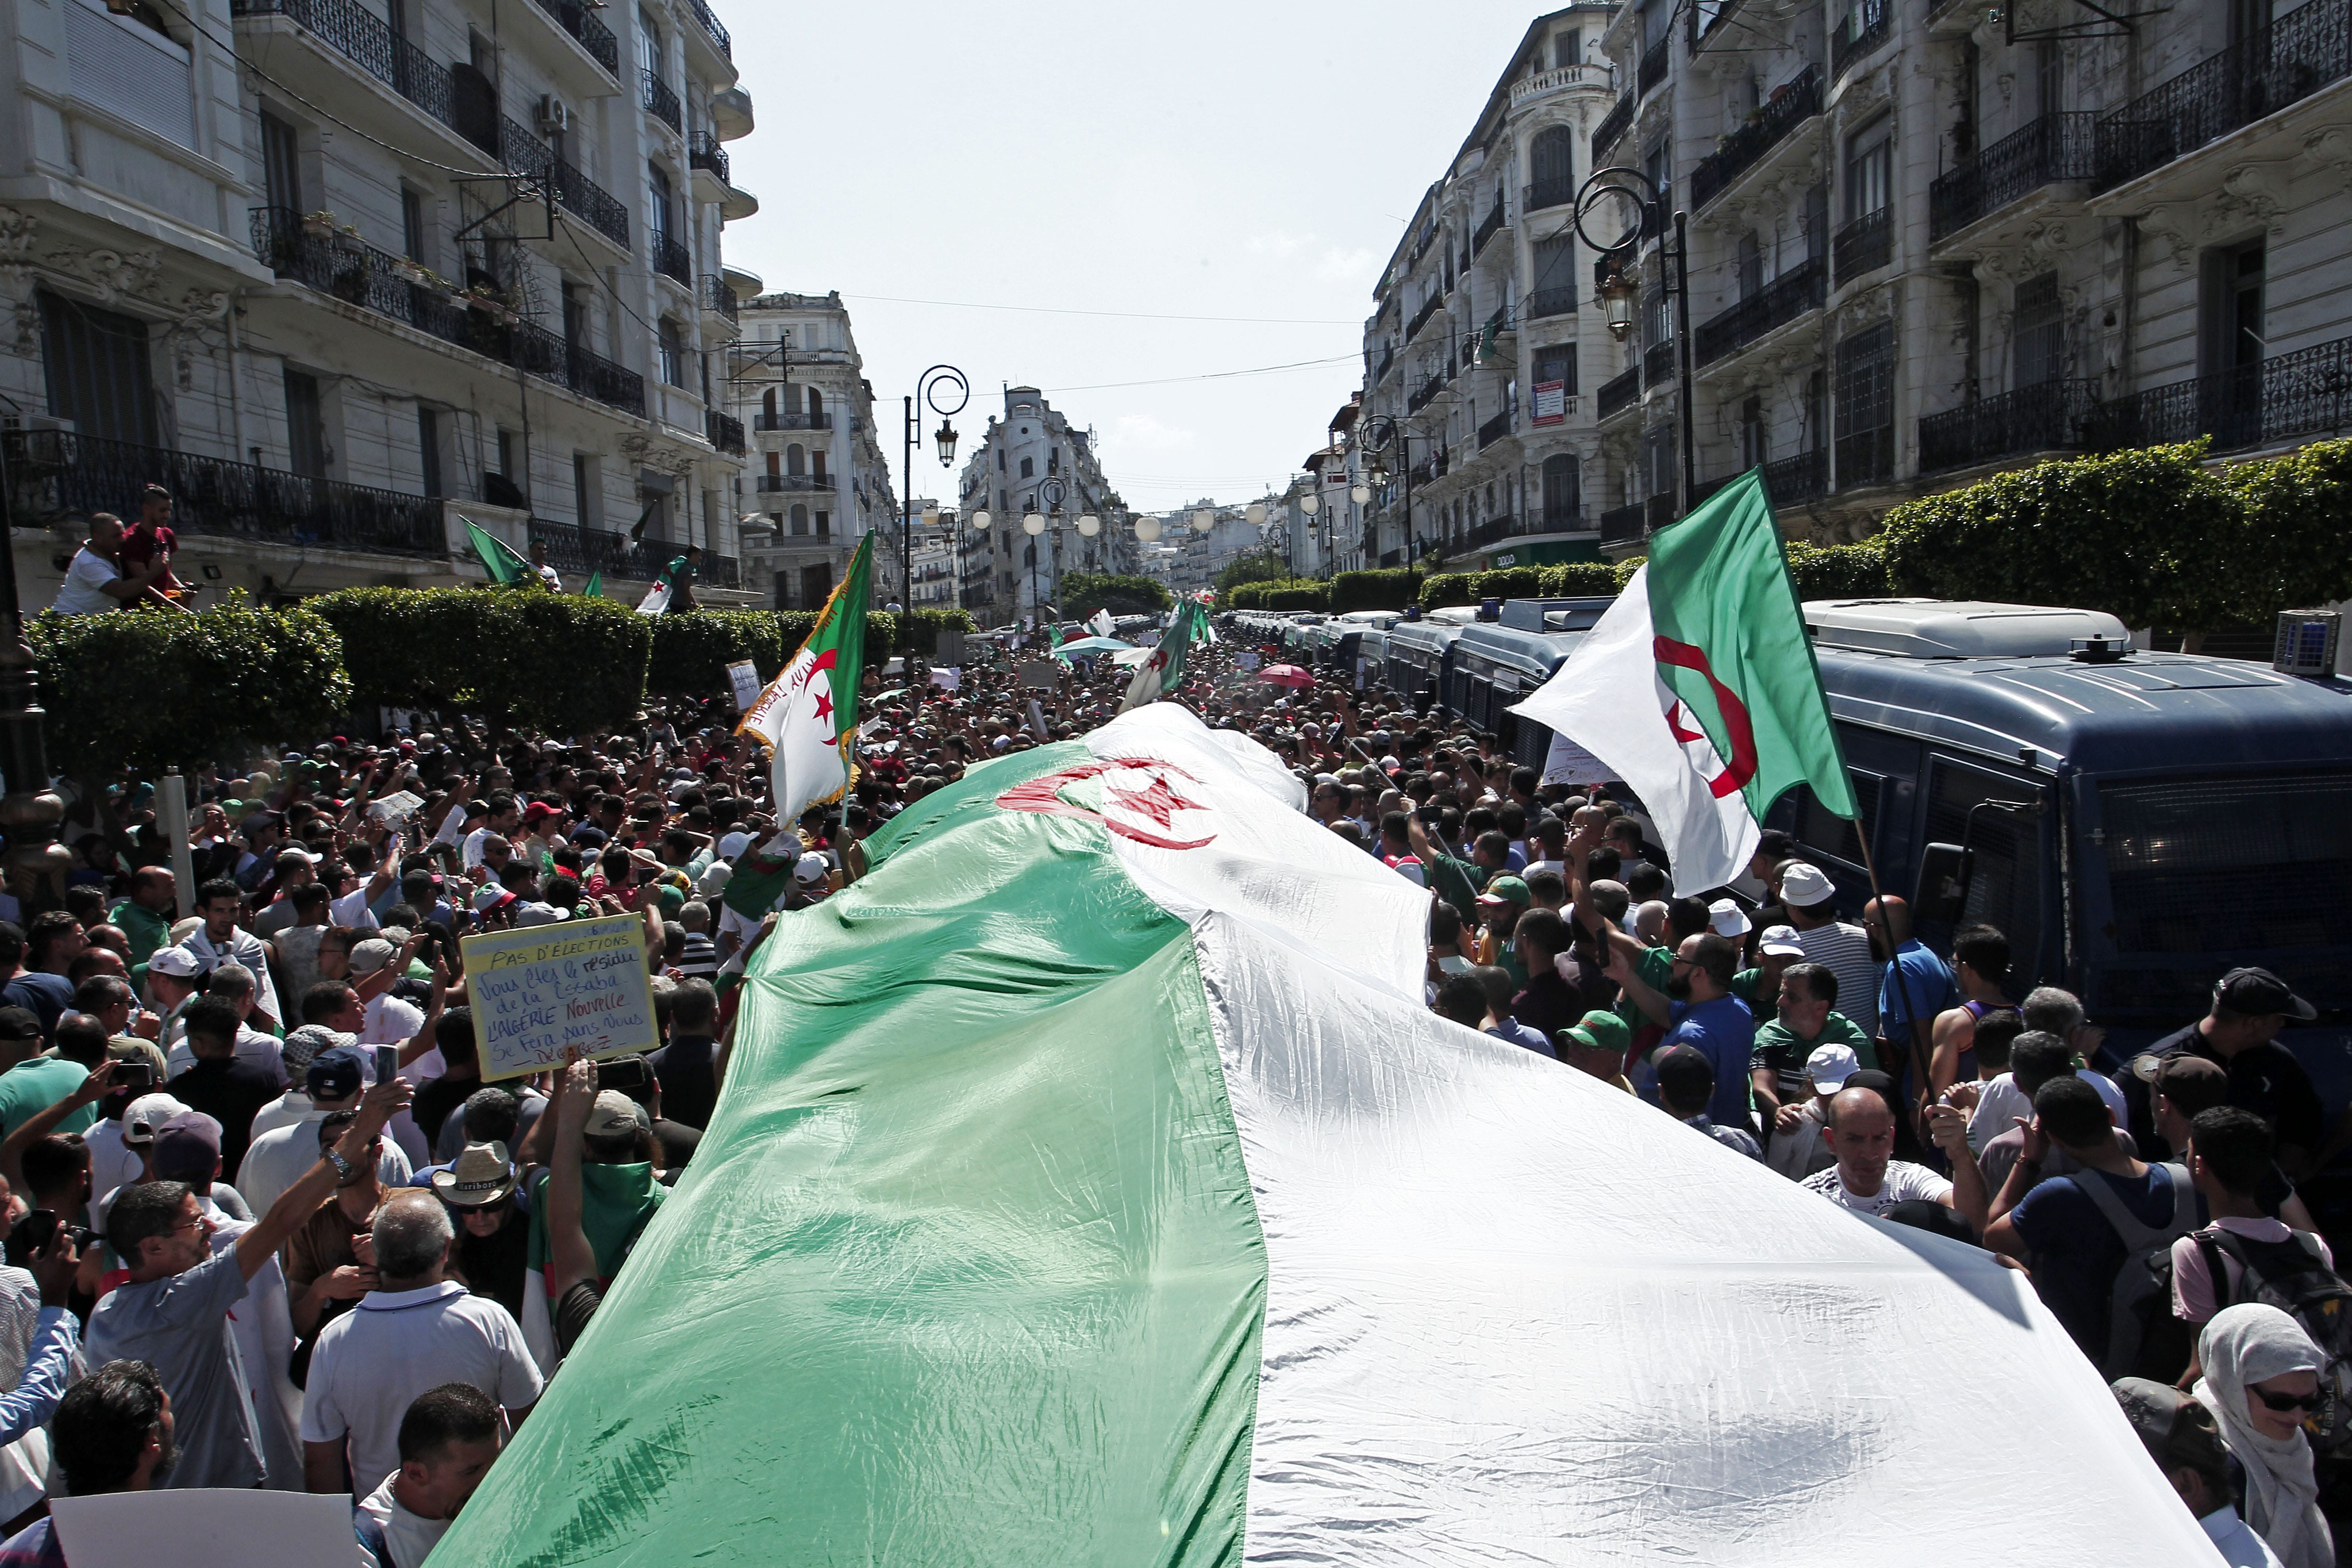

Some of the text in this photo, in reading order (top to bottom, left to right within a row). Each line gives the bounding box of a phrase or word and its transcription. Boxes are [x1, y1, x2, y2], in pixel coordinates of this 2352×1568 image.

[491, 937, 629, 969] PAS D'ÉLECTIONS
[477, 952, 639, 1002] Vous êtes le résidu
[497, 998, 518, 1014] de
[522, 991, 544, 1005] la
